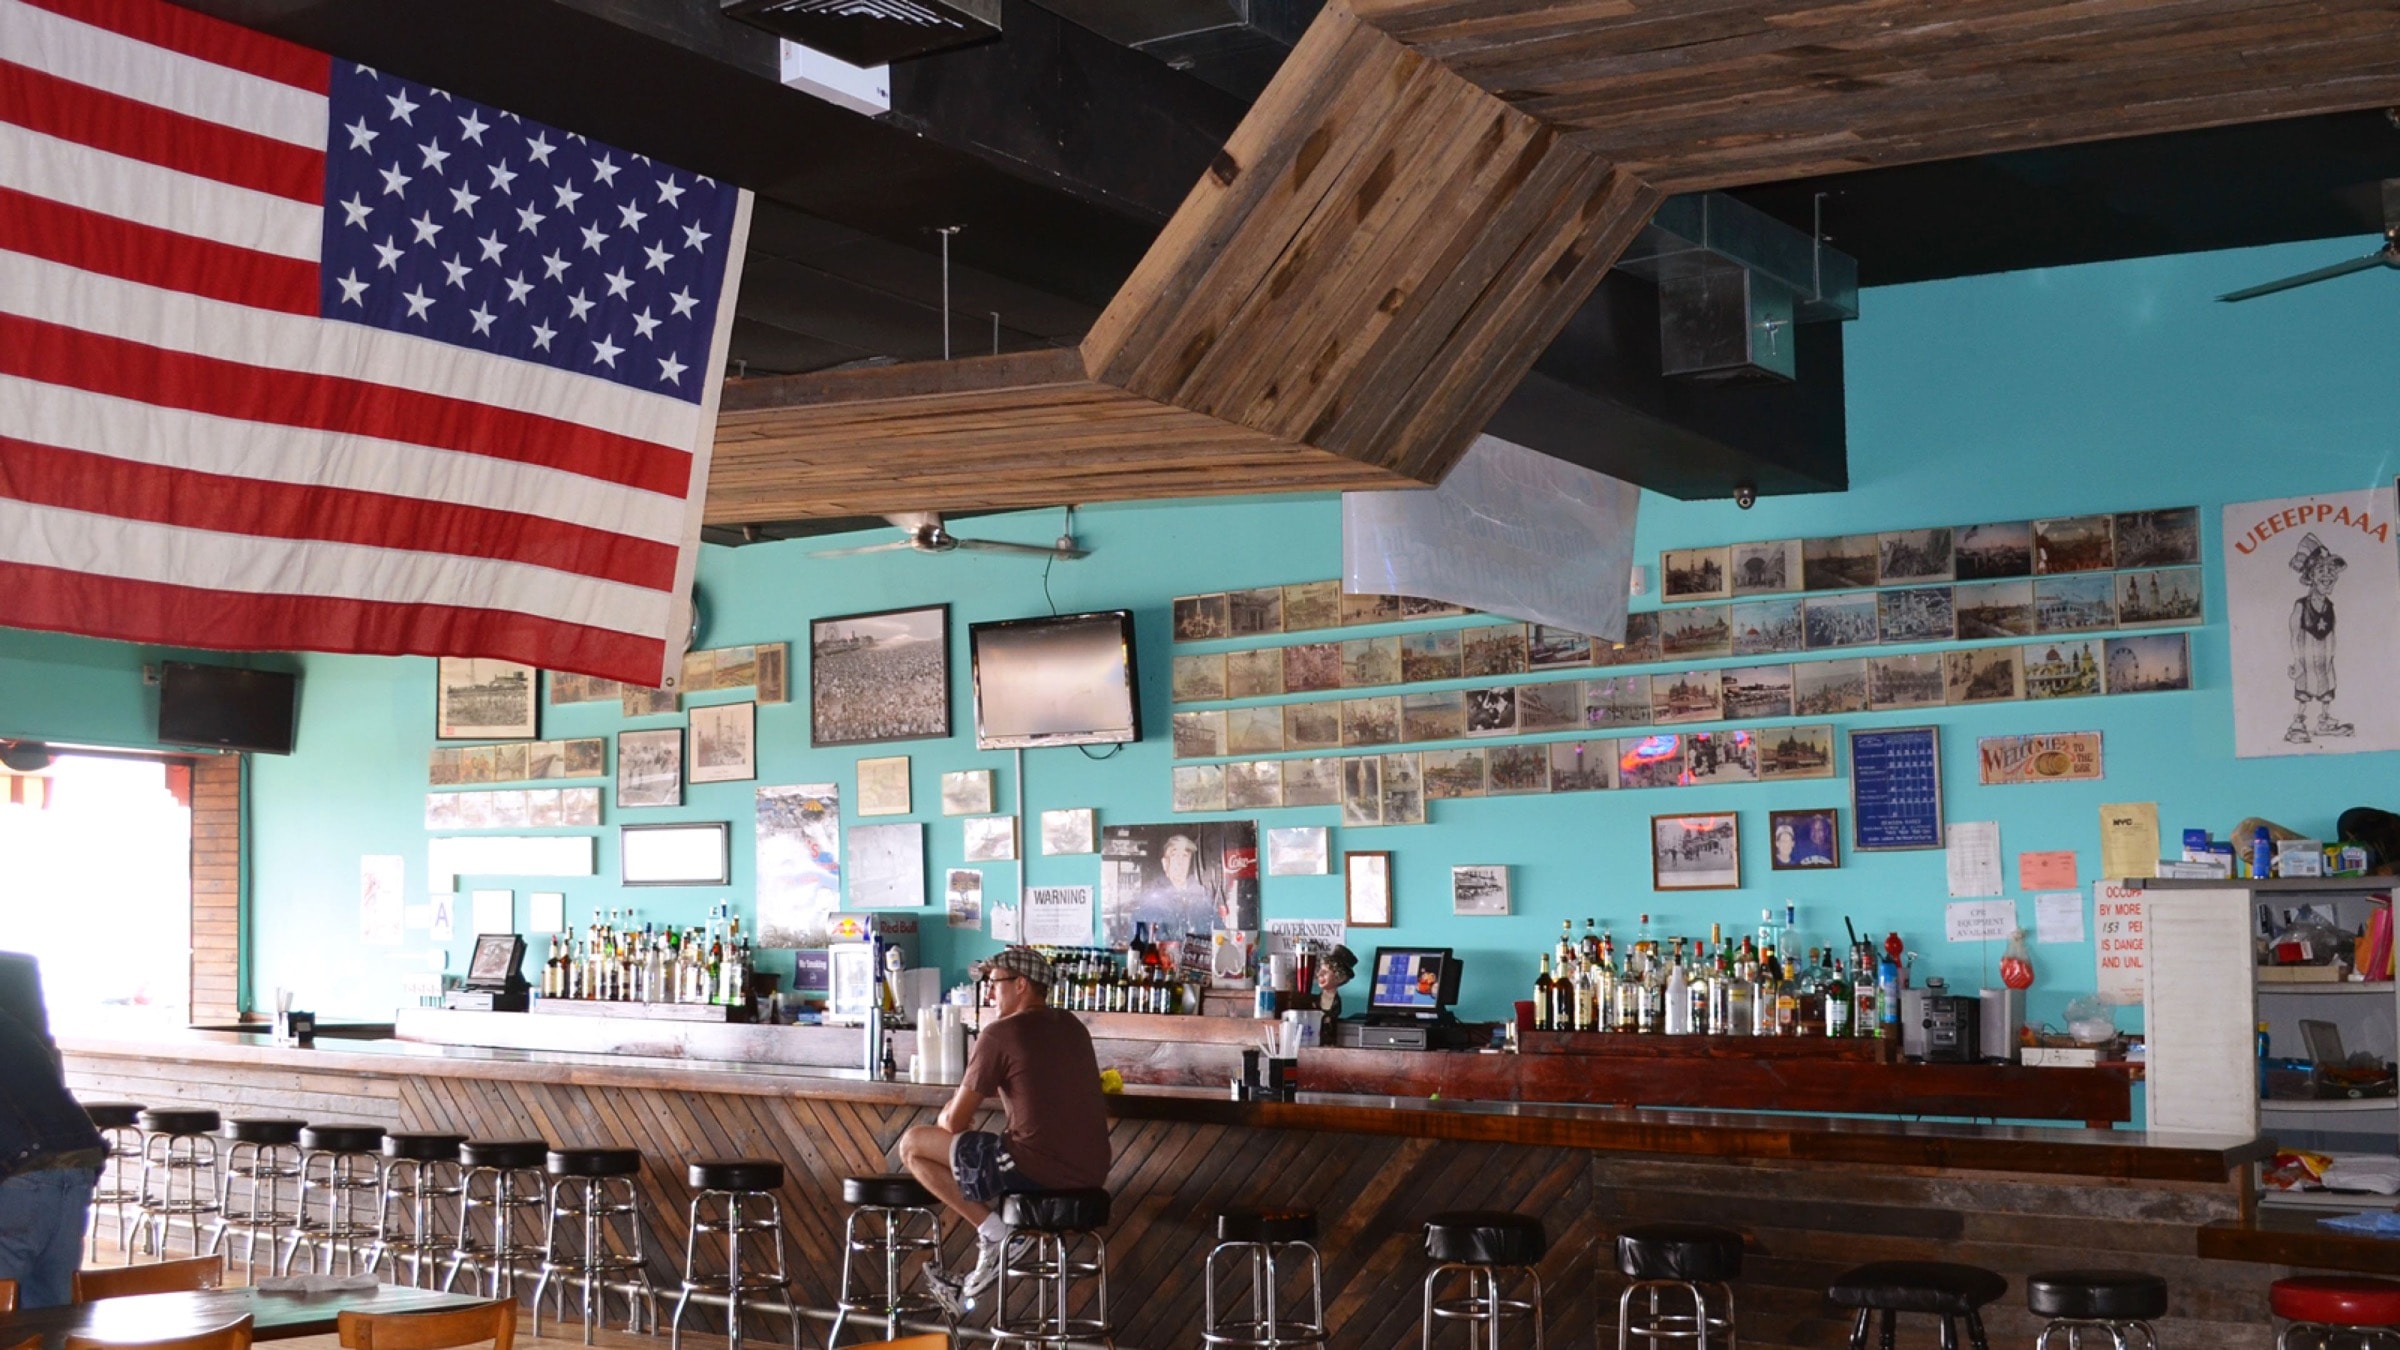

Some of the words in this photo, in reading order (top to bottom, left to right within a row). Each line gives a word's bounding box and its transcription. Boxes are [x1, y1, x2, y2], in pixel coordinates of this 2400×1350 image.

[2235, 504, 2388, 554] UEEEPPAAA
[1034, 889, 1086, 905] WARNING
[2100, 904, 2111, 916] BY
[2115, 903, 2142, 916] MORE
[1958, 918, 2004, 926] EQUIPMENT
[2102, 922, 2120, 934] 153
[1272, 923, 1342, 936] GOVERNMENT
[1956, 928, 2002, 936] AVAILABLE
[2101, 939, 2111, 950] IS
[2102, 957, 2120, 968] AND
[2124, 956, 2144, 968] UNL
